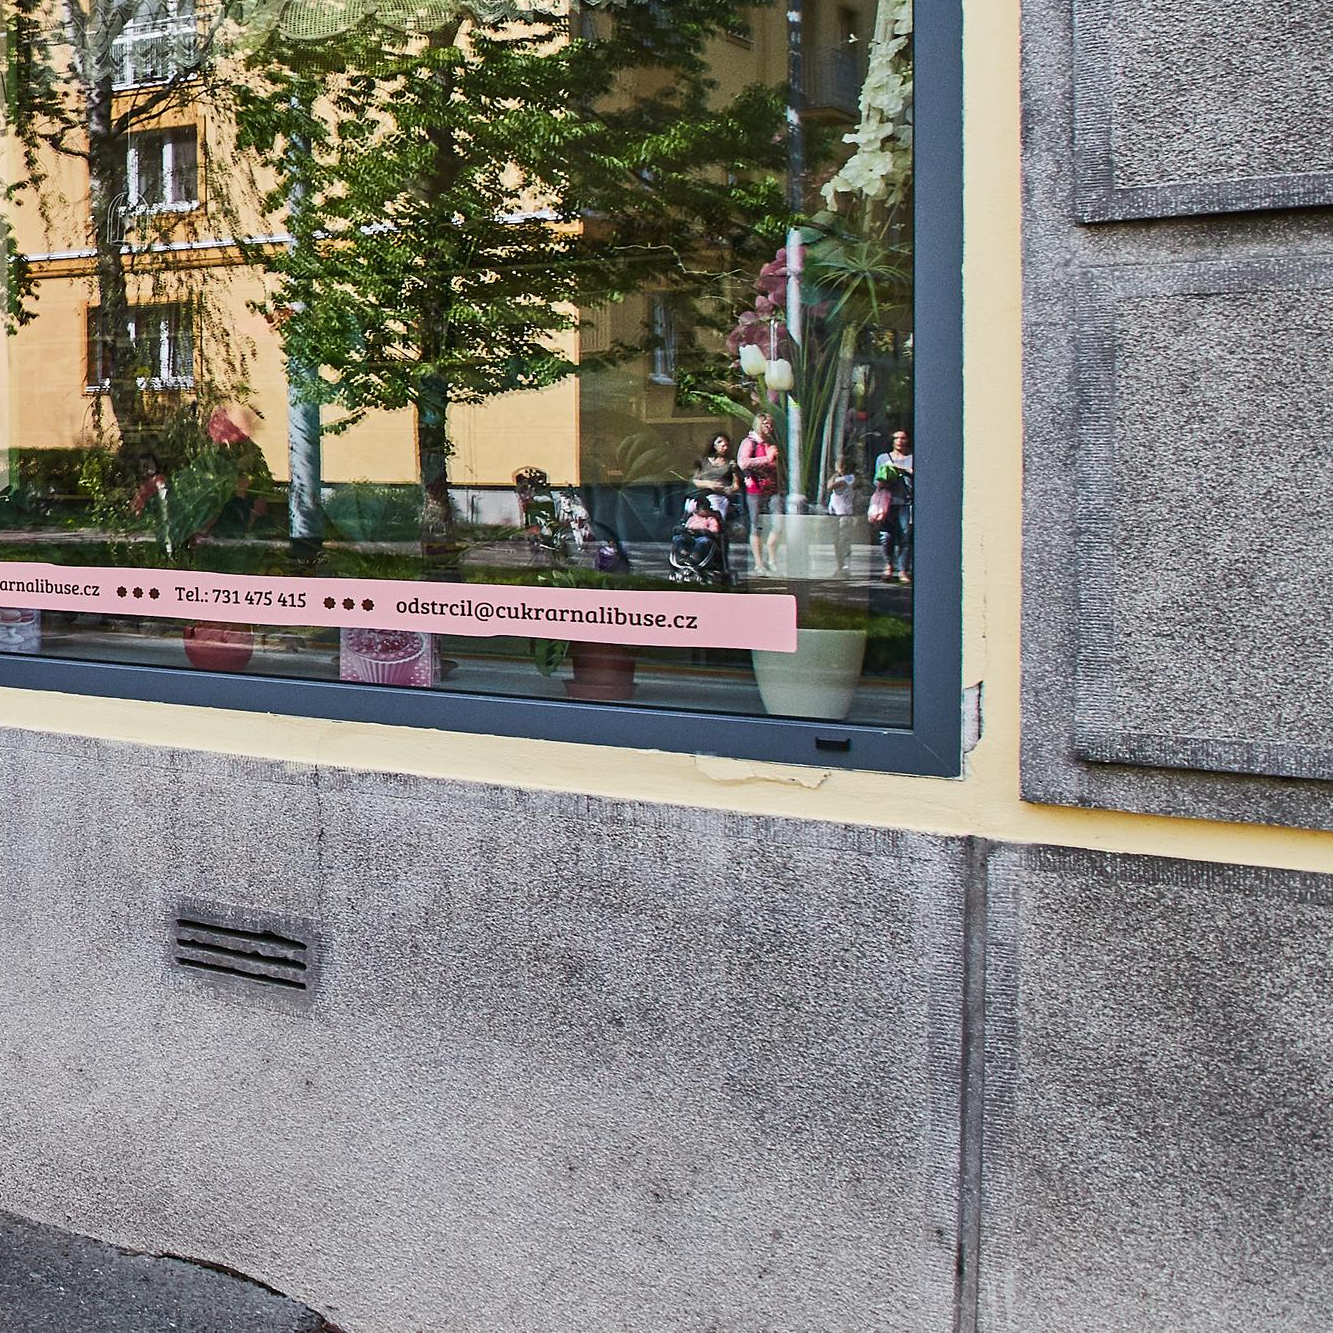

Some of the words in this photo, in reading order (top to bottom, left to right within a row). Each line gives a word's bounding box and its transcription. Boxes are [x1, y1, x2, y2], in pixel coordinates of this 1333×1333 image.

[175, 586, 209, 604] Tel.:
[212, 588, 240, 605] 731
[244, 589, 273, 607] 475
[277, 590, 307, 609] 415
[396, 597, 698, 630] odstrcil@cukrarnalibuse.cz
